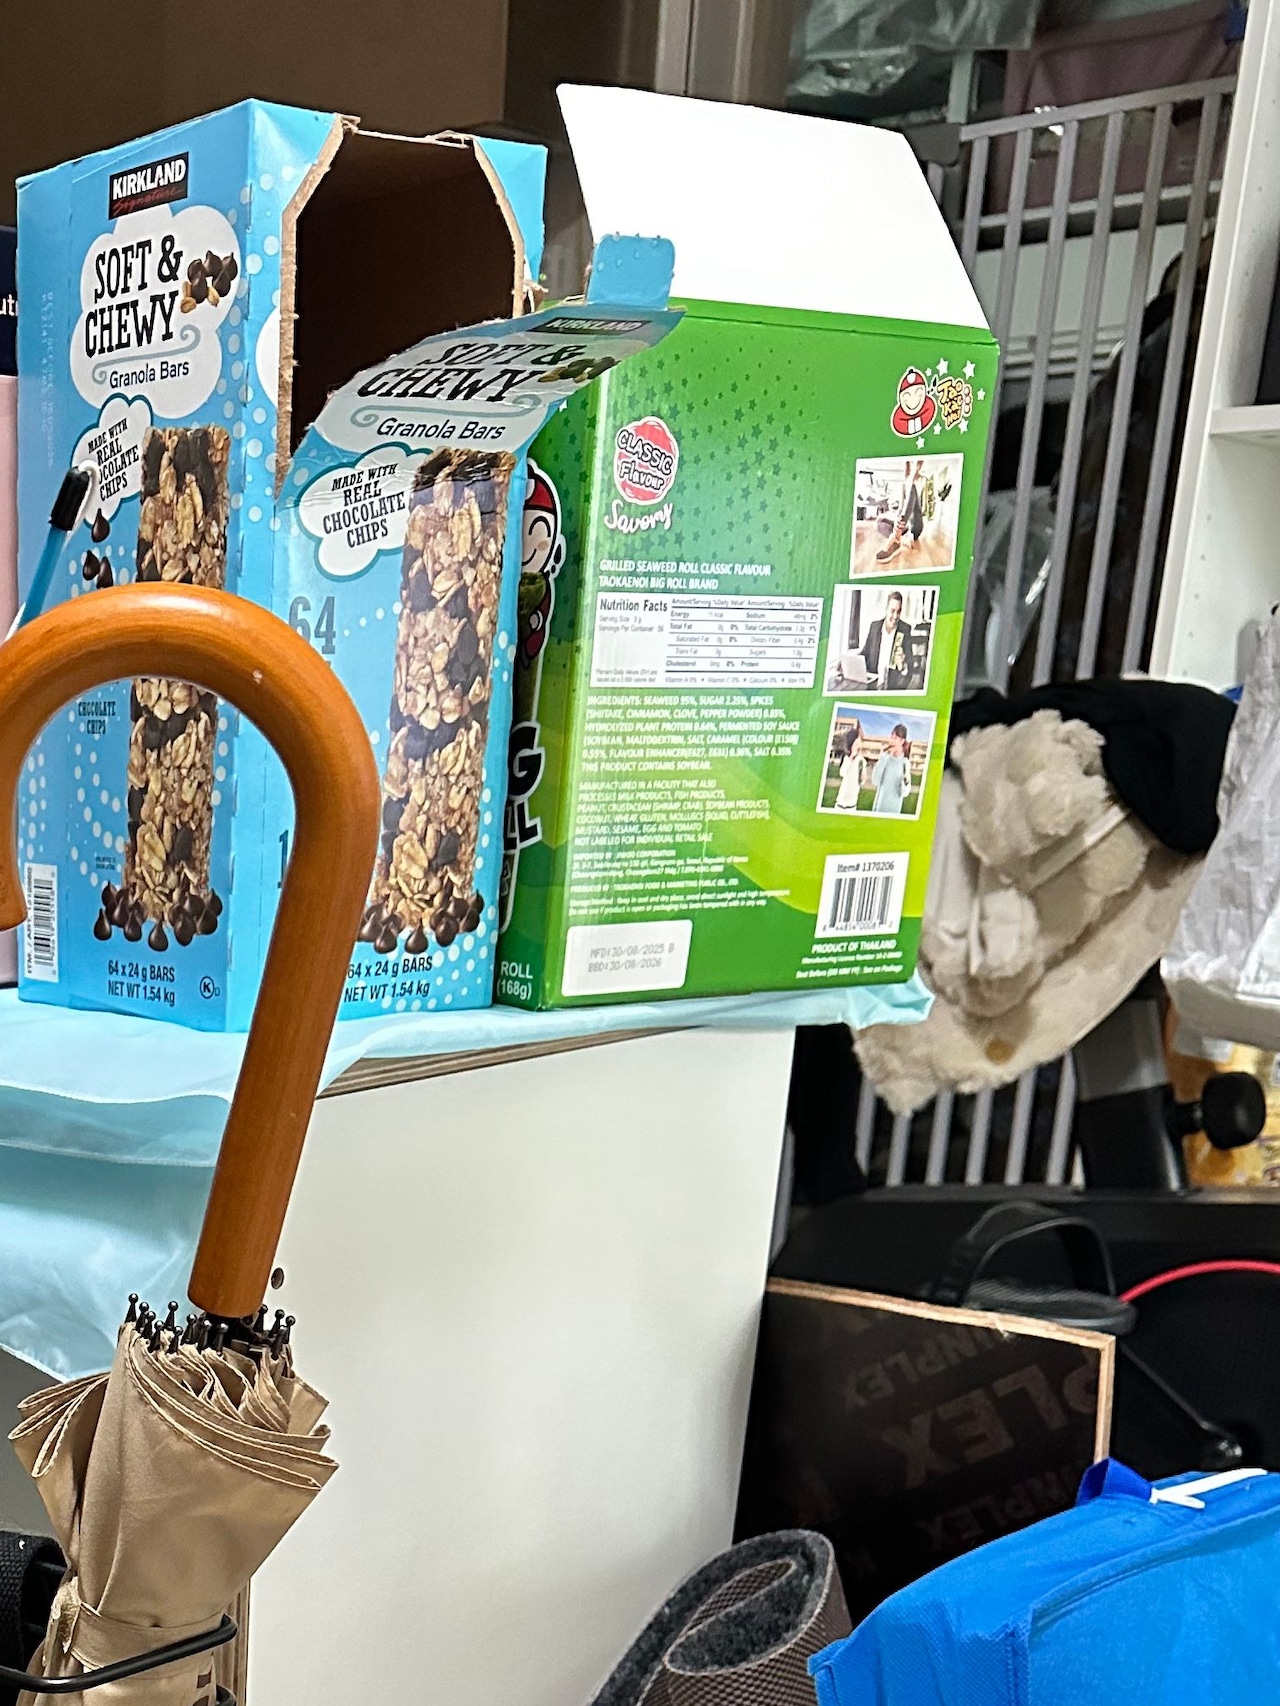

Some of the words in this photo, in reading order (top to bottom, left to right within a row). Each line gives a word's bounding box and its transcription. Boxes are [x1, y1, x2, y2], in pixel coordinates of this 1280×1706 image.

[112, 158, 186, 200] KIRKLAND
[94, 238, 152, 304] SOFT
[157, 234, 184, 283] &
[85, 290, 179, 359] CHEWY
[545, 318, 643, 332] KIRKLAND
[416, 343, 533, 366] SOFT
[532, 344, 587, 365] &
[109, 363, 156, 389] Granola
[160, 360, 190, 380] Bars
[357, 368, 547, 402] CHEWY
[88, 432, 108, 454] MADE
[108, 417, 128, 441] WITH
[377, 417, 456, 439] Granola
[458, 422, 506, 440] Bars
[96, 438, 123, 467] REAL
[99, 444, 140, 484] COLATE
[617, 429, 673, 475] CLASSIC
[99, 472, 128, 502] CHIPS
[331, 471, 364, 491] MADE
[368, 463, 398, 480] WITH
[620, 460, 664, 490] Flavour
[343, 480, 383, 507] REAL
[323, 491, 406, 535] CHOCOLATE
[603, 499, 673, 534] Savory
[347, 518, 389, 548] CHIPS
[600, 559, 635, 572] GRILLED
[636, 560, 676, 573] SEAWEED
[678, 561, 699, 574] ROLL
[700, 564, 733, 575] CLASSIC
[734, 564, 771, 576] FLAVOUR
[649, 577, 665, 589] BIG
[666, 578, 687, 589] ROLL
[689, 578, 719, 590] BRAND
[600, 598, 640, 611] Nutrition
[643, 600, 668, 612] Facts
[288, 596, 336, 655] 64
[78, 701, 116, 717] CHOCOLATE
[86, 719, 107, 734] CHIPS
[837, 864, 860, 872] Item#
[862, 860, 894, 872] 1370206
[812, 943, 848, 953] PRODUCT
[848, 942, 859, 951] OF
[860, 939, 897, 950] THAILAND
[108, 959, 120, 977] 64
[120, 964, 127, 977] x
[128, 962, 140, 979] 24
[142, 967, 147, 982] g
[149, 963, 175, 983] BARS
[347, 963, 361, 979] 64
[365, 965, 371, 976] x
[374, 961, 388, 977] 24
[392, 962, 399, 977] g
[402, 955, 433, 973] BARS
[500, 961, 533, 979] ROLL
[108, 980, 125, 998] NET
[127, 982, 141, 999] WT
[142, 983, 162, 1003] 1.54
[164, 986, 176, 1006] kg
[344, 986, 367, 1003] NET
[370, 984, 387, 1000] WT
[391, 982, 413, 998] 1.54
[416, 980, 429, 997] kg
[496, 980, 532, 1000] (168g)
